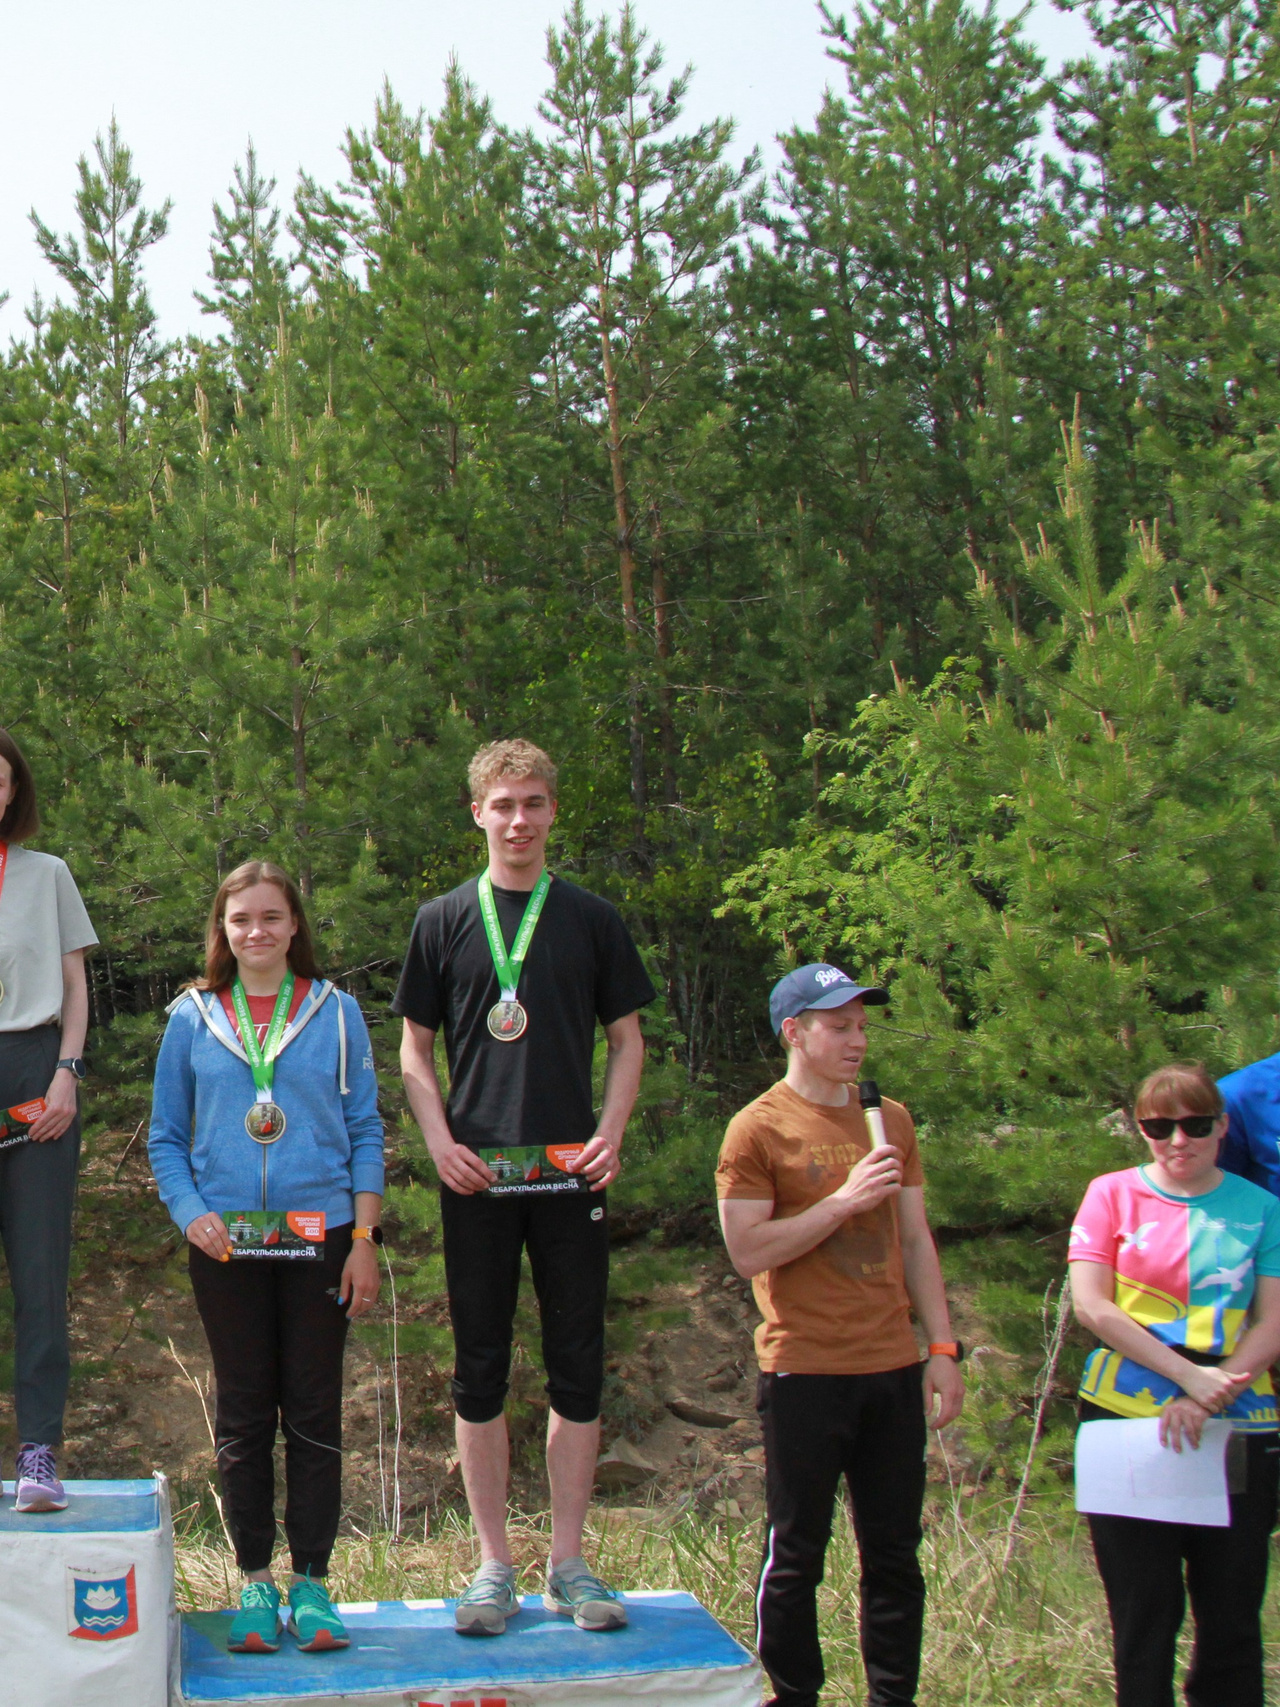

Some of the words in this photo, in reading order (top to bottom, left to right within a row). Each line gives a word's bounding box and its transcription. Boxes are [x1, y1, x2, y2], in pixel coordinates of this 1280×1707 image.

[810, 1144, 856, 1165] STAY
[488, 1184, 552, 1193] ЧЕБАРКУЛЬСКАЯ
[552, 1182, 579, 1190] ВЕСНА
[231, 1248, 290, 1256] ЕБАРКУЛЬСКАЯ
[291, 1249, 316, 1257] ВЕСНА
